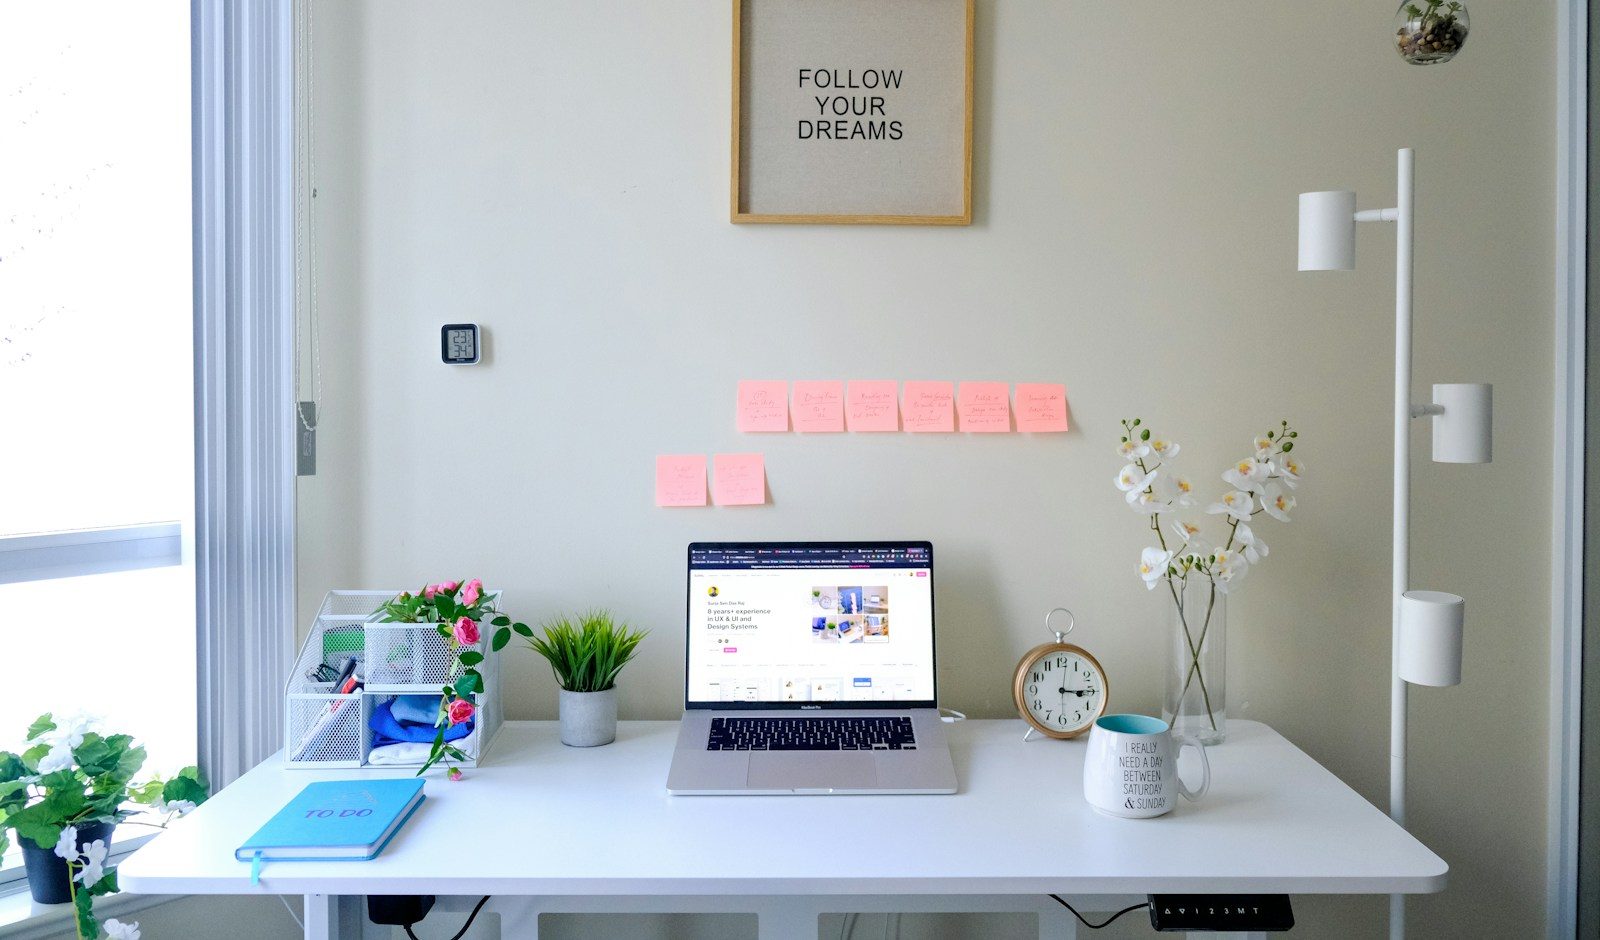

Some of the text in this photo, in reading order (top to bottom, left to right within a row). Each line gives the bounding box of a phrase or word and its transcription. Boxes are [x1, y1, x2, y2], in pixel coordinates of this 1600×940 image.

[799, 69, 903, 89] FOLLOW
[814, 96, 886, 116] YOUR
[798, 120, 903, 140] DREAMS
[707, 623, 758, 631] Design Systems
[1044, 661, 1051, 672] 11
[1056, 656, 1068, 669] 12
[1074, 661, 1078, 672] 1
[1033, 671, 1044, 683] 10
[1083, 671, 1091, 682] 2
[1029, 684, 1038, 697] 9
[1033, 699, 1042, 711] 8
[1045, 709, 1053, 721] 7
[1058, 713, 1067, 726] 6
[1073, 710, 1081, 722] 5
[1131, 742, 1158, 754] REALLY
[1119, 756, 1164, 768] NEED A DAY
[1123, 770, 1161, 782] BETWEEN
[1123, 783, 1162, 796] SATURDAY
[1124, 797, 1167, 810] & SUNDAY
[304, 808, 373, 819] TO DO
[1209, 907, 1215, 915] 2
[1224, 907, 1229, 915] 3
[1237, 907, 1245, 915] M
[1252, 907, 1259, 915] T
